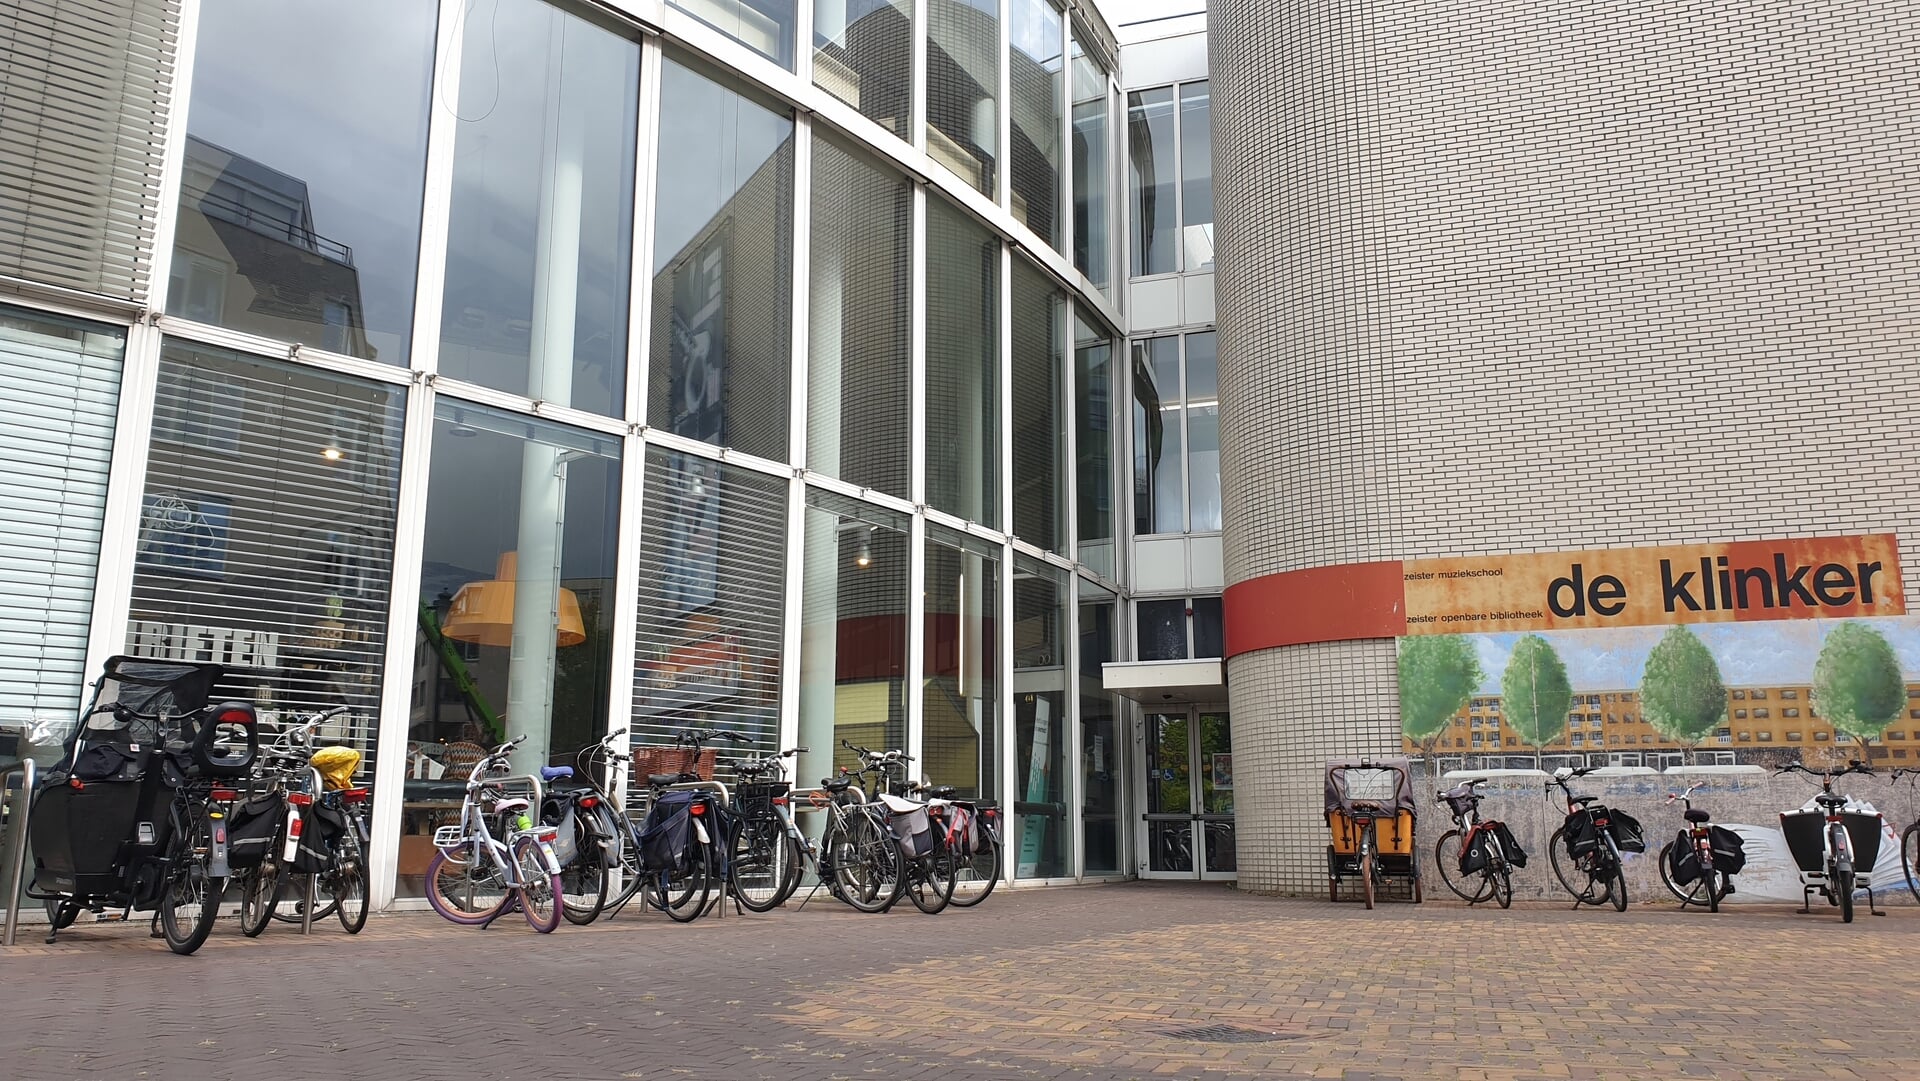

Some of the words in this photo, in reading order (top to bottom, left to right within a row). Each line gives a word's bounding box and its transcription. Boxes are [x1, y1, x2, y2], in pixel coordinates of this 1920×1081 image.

[1403, 571, 1435, 581] zeister
[1438, 567, 1504, 579] muziekschool
[1547, 563, 1627, 617] de
[1660, 552, 1882, 613] klinker
[1406, 614, 1438, 624] zeister
[1440, 611, 1487, 623] openbare
[1489, 610, 1544, 620] bibliotheek
